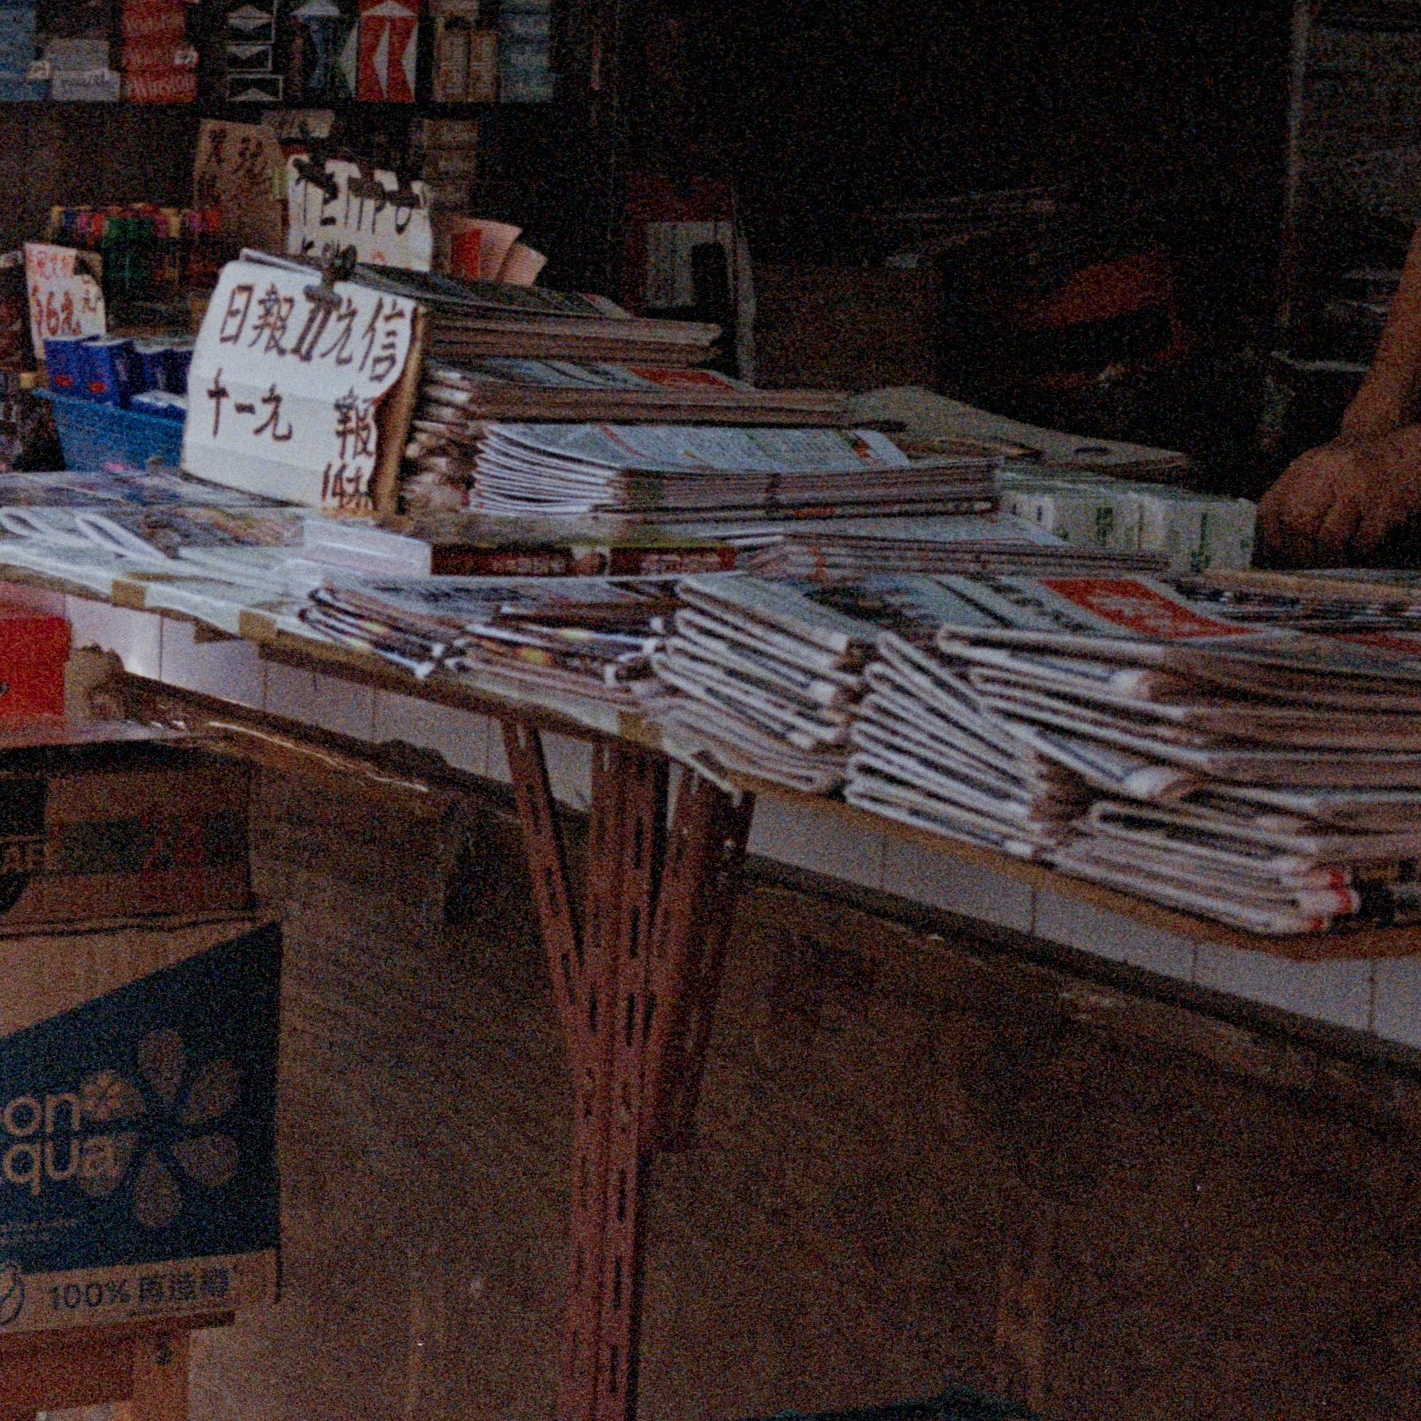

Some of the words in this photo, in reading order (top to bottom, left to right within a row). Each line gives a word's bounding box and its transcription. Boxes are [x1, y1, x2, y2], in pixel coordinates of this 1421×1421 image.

[206, 367, 293, 441] 十一元
[49, 1282, 131, 1311] 100%
